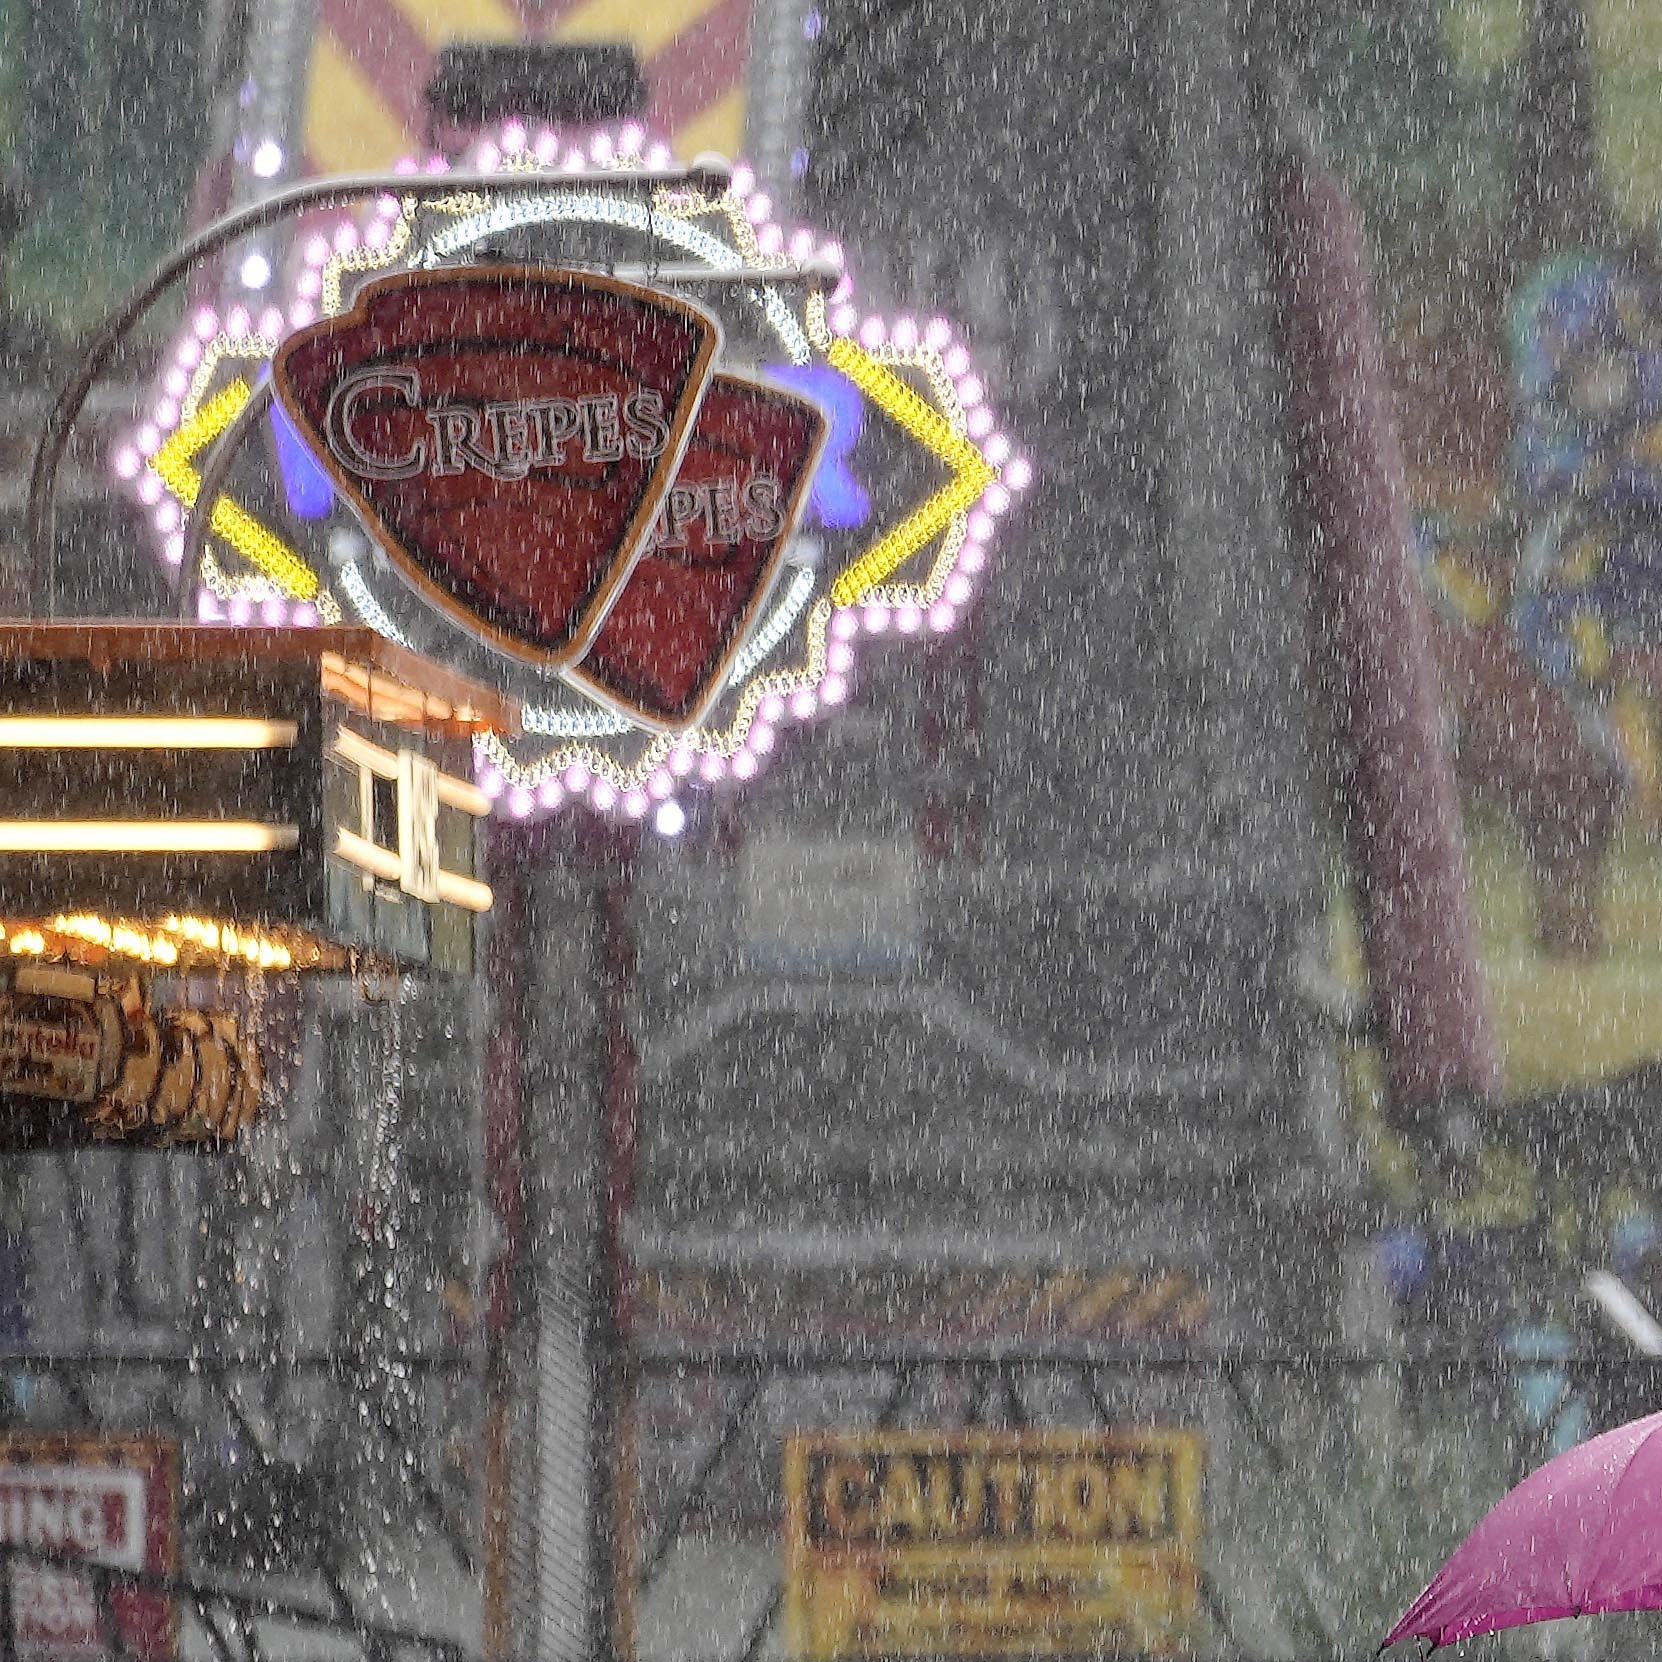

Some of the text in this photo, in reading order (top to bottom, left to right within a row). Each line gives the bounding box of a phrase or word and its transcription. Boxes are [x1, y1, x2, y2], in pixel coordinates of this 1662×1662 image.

[650, 472, 785, 553] PES
[0, 1492, 104, 1548] ING
[824, 1459, 1166, 1534] CAUTION
